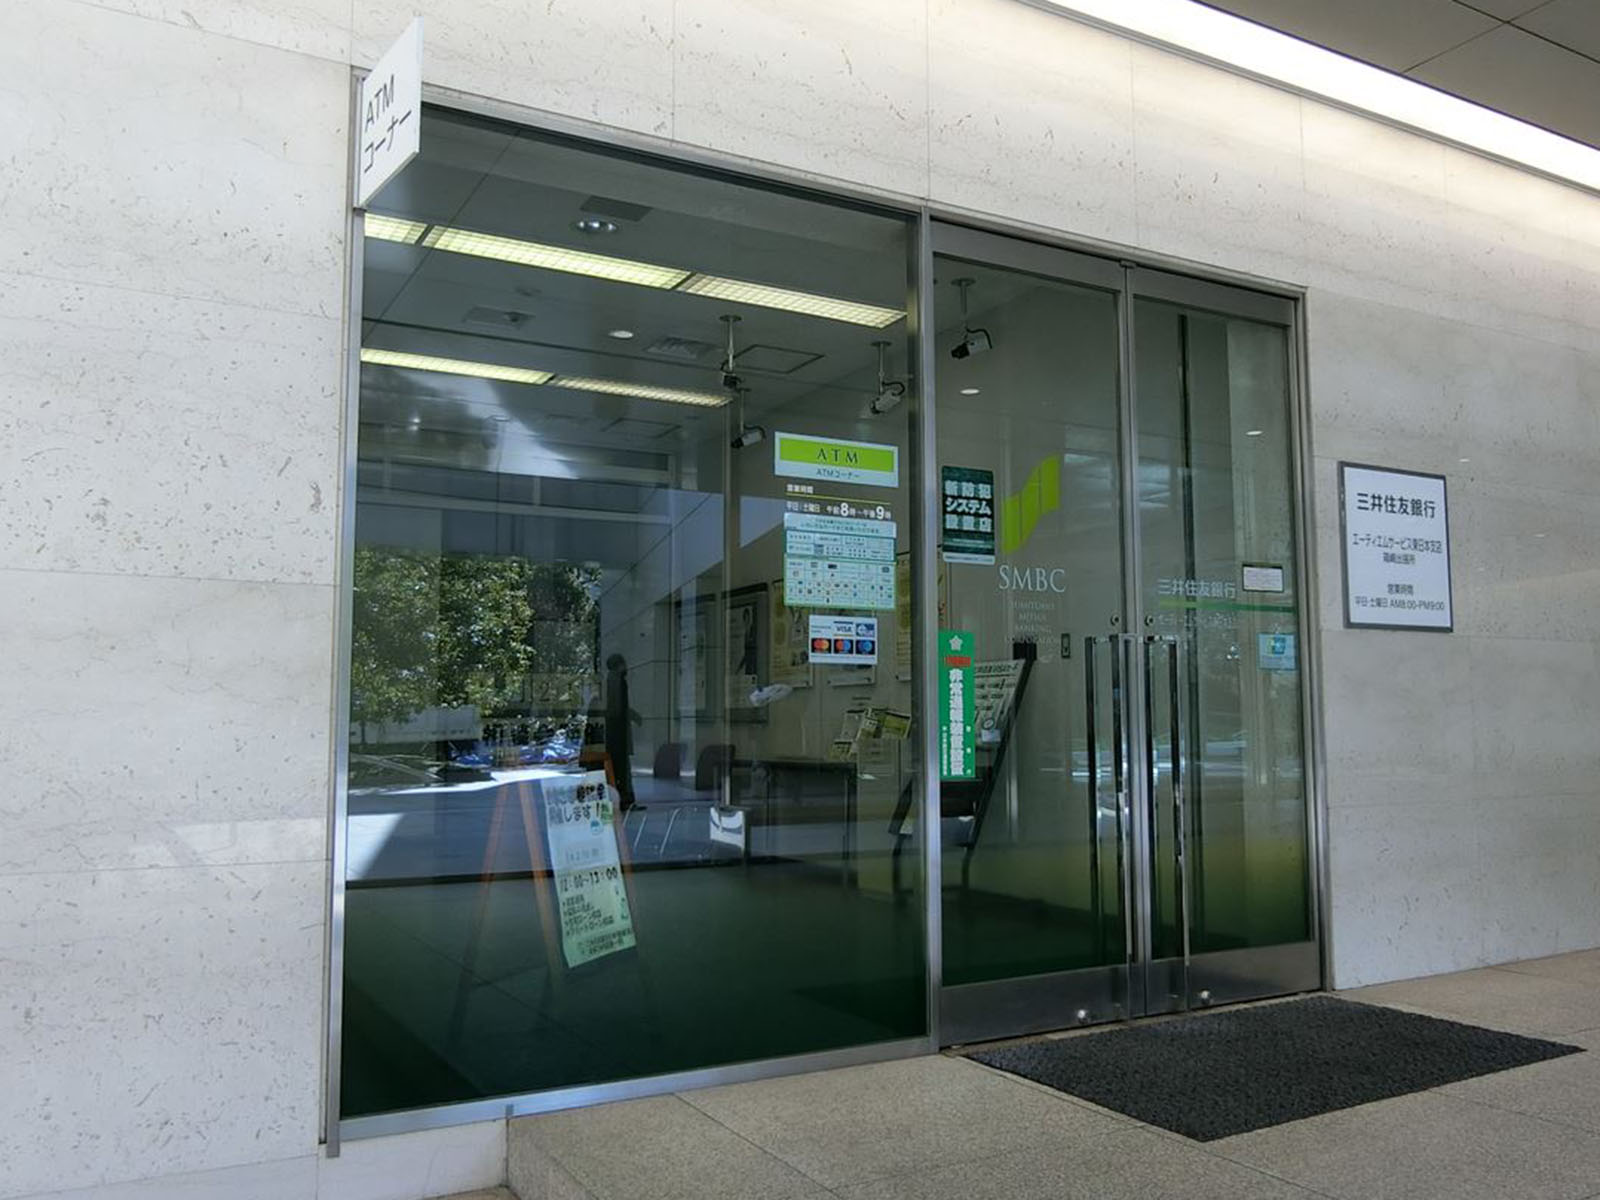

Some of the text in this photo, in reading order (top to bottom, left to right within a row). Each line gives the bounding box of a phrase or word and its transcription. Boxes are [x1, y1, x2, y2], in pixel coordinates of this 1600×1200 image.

[364, 74, 395, 133] ATM
[364, 110, 412, 174] コーナー
[817, 447, 860, 464] ATM
[944, 496, 992, 515] システム
[1356, 492, 1436, 519] 三井住友銀行
[998, 564, 1067, 593] SMBC
[1157, 578, 1236, 599] 三井住友銀行
